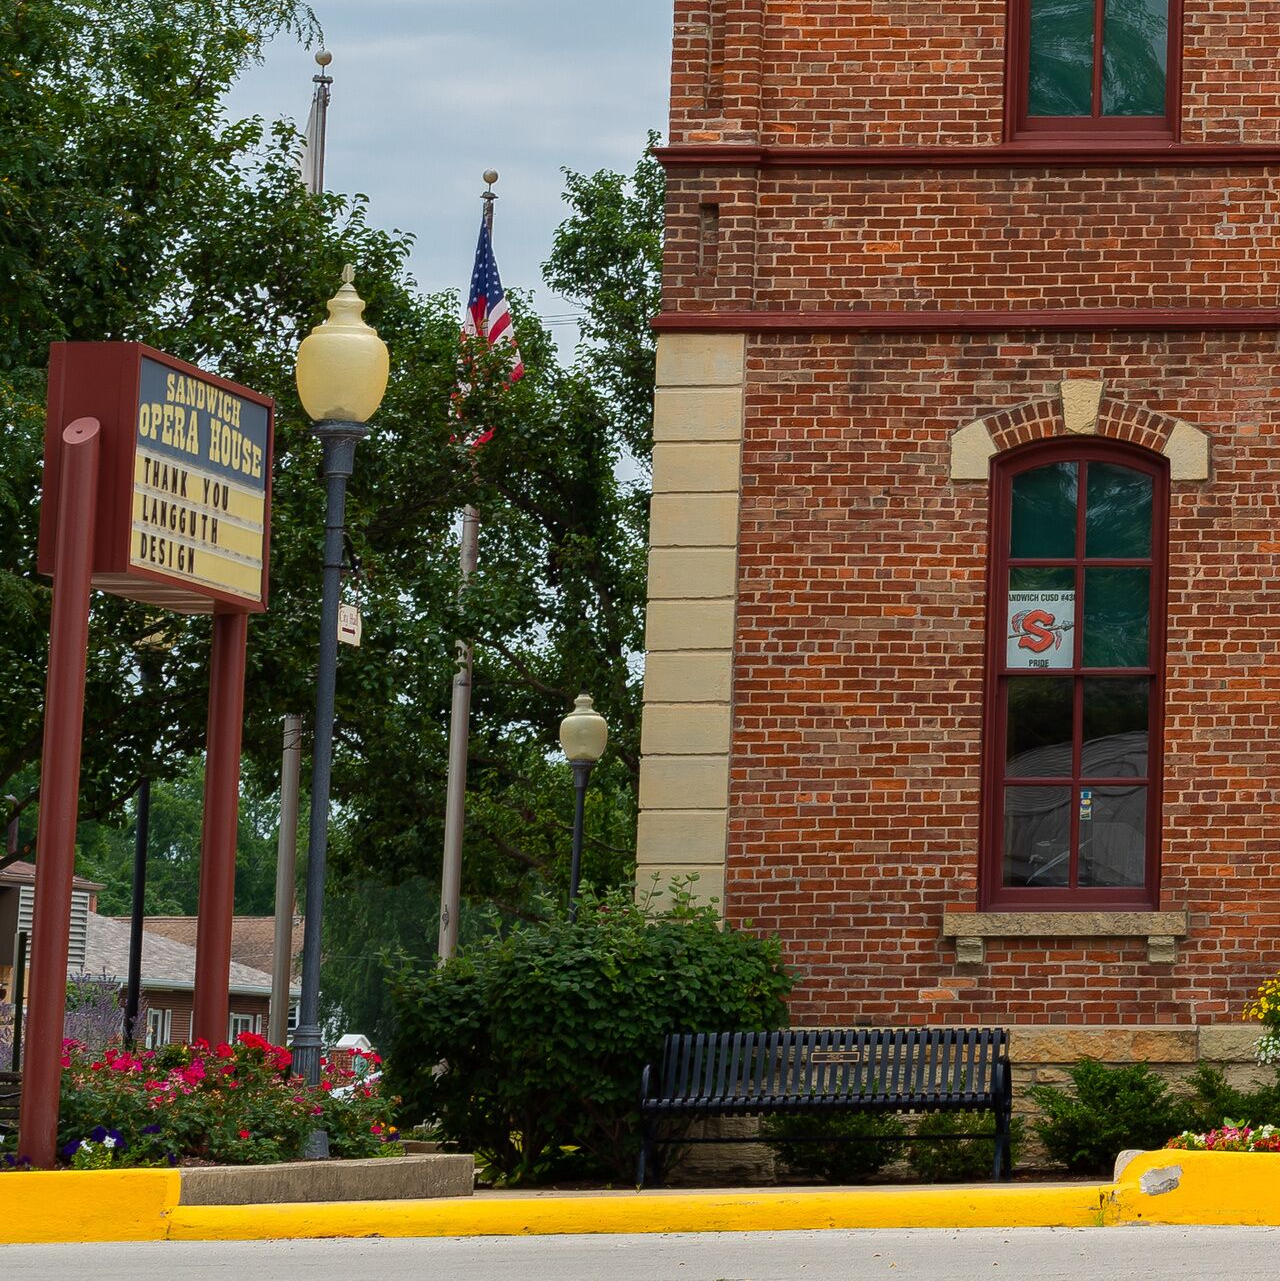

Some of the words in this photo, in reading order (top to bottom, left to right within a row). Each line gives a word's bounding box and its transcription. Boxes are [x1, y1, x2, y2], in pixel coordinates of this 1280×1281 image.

[166, 373, 241, 428] SANDWICH
[139, 403, 199, 455] OPERA
[209, 418, 262, 478] HOUSE
[144, 457, 188, 498] THANK
[203, 478, 229, 511] YOU
[142, 494, 218, 544] LANGGUTH
[140, 532, 195, 574] DESIGN
[1041, 593, 1059, 602] CUSD
[1018, 609, 1055, 653] S
[1028, 659, 1049, 668] PRIDE
